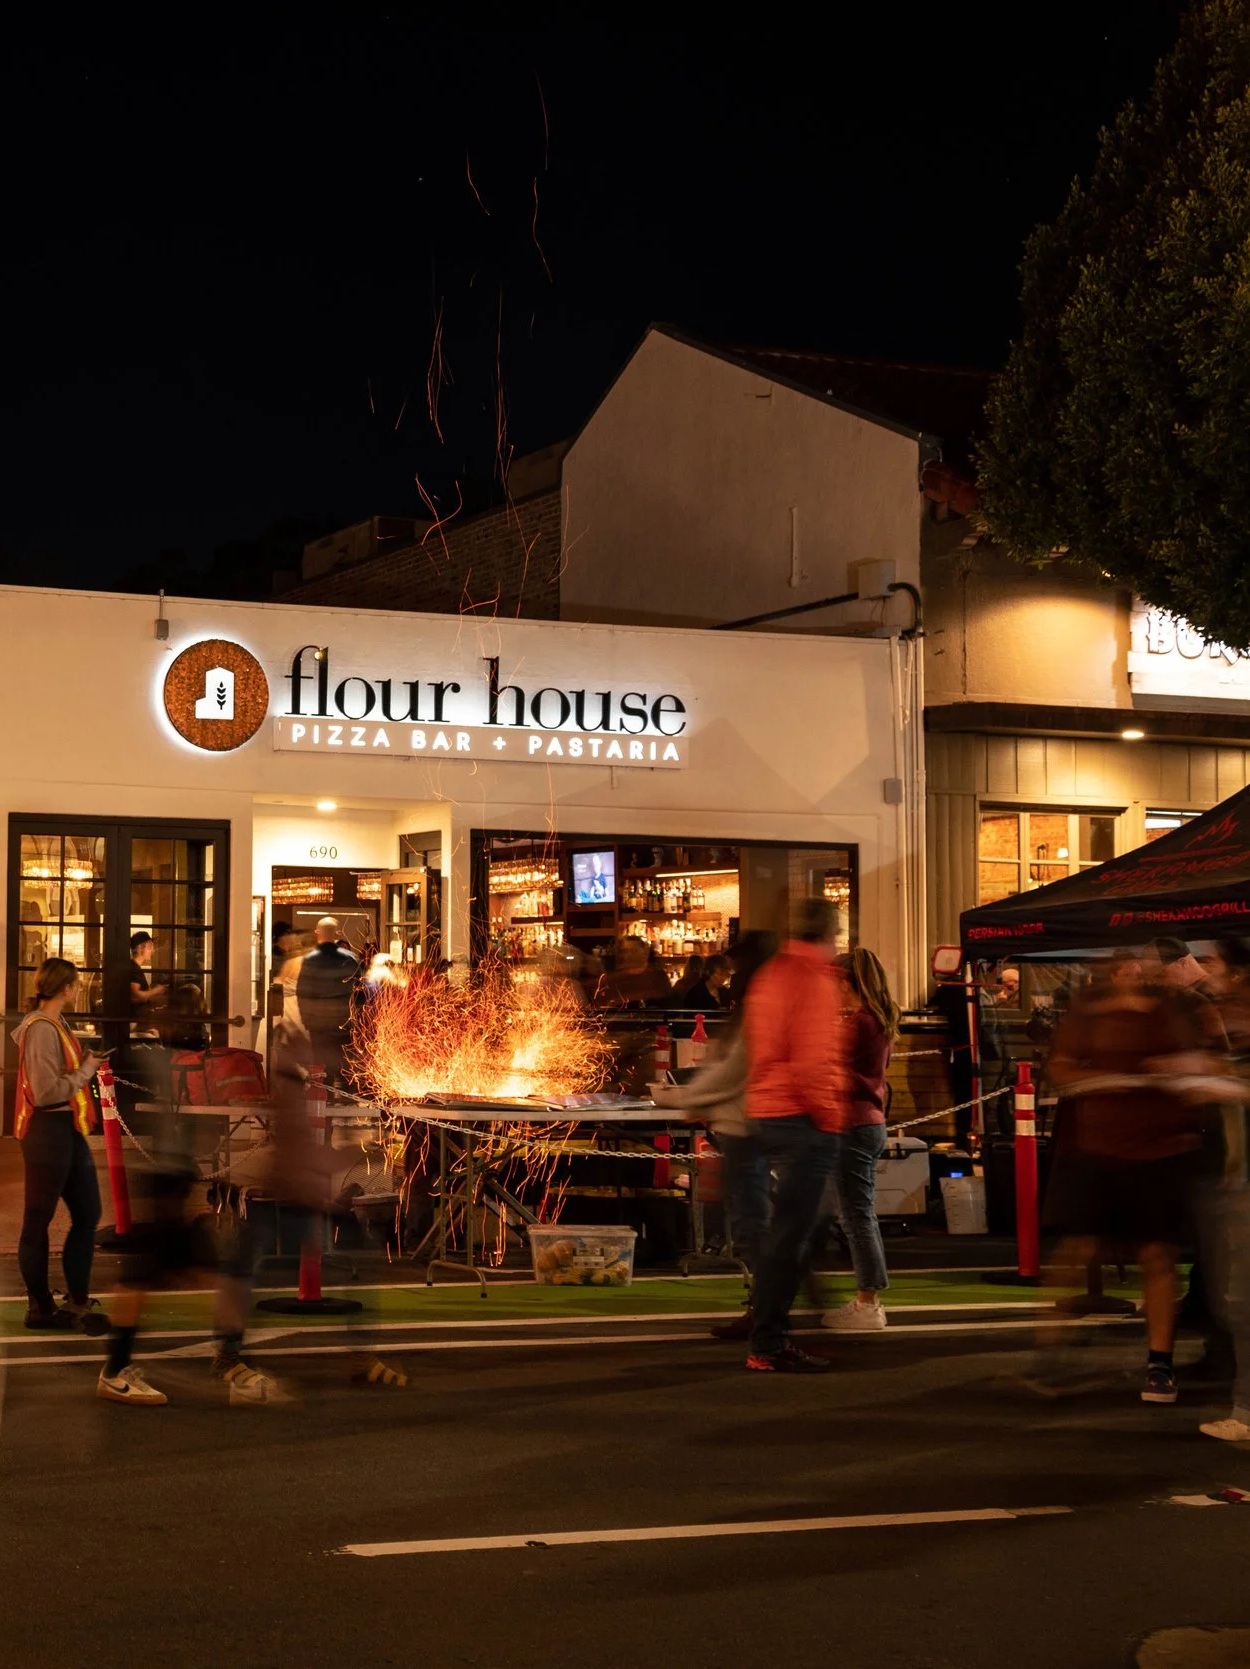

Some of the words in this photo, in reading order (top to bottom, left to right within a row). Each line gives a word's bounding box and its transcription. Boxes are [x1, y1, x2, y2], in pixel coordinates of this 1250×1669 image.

[284, 645, 461, 722] flour
[479, 655, 687, 736] house
[291, 723, 391, 748] PIZZA
[411, 729, 471, 752] BAR
[528, 735, 680, 762] PASTARIA
[309, 845, 338, 860] 690
